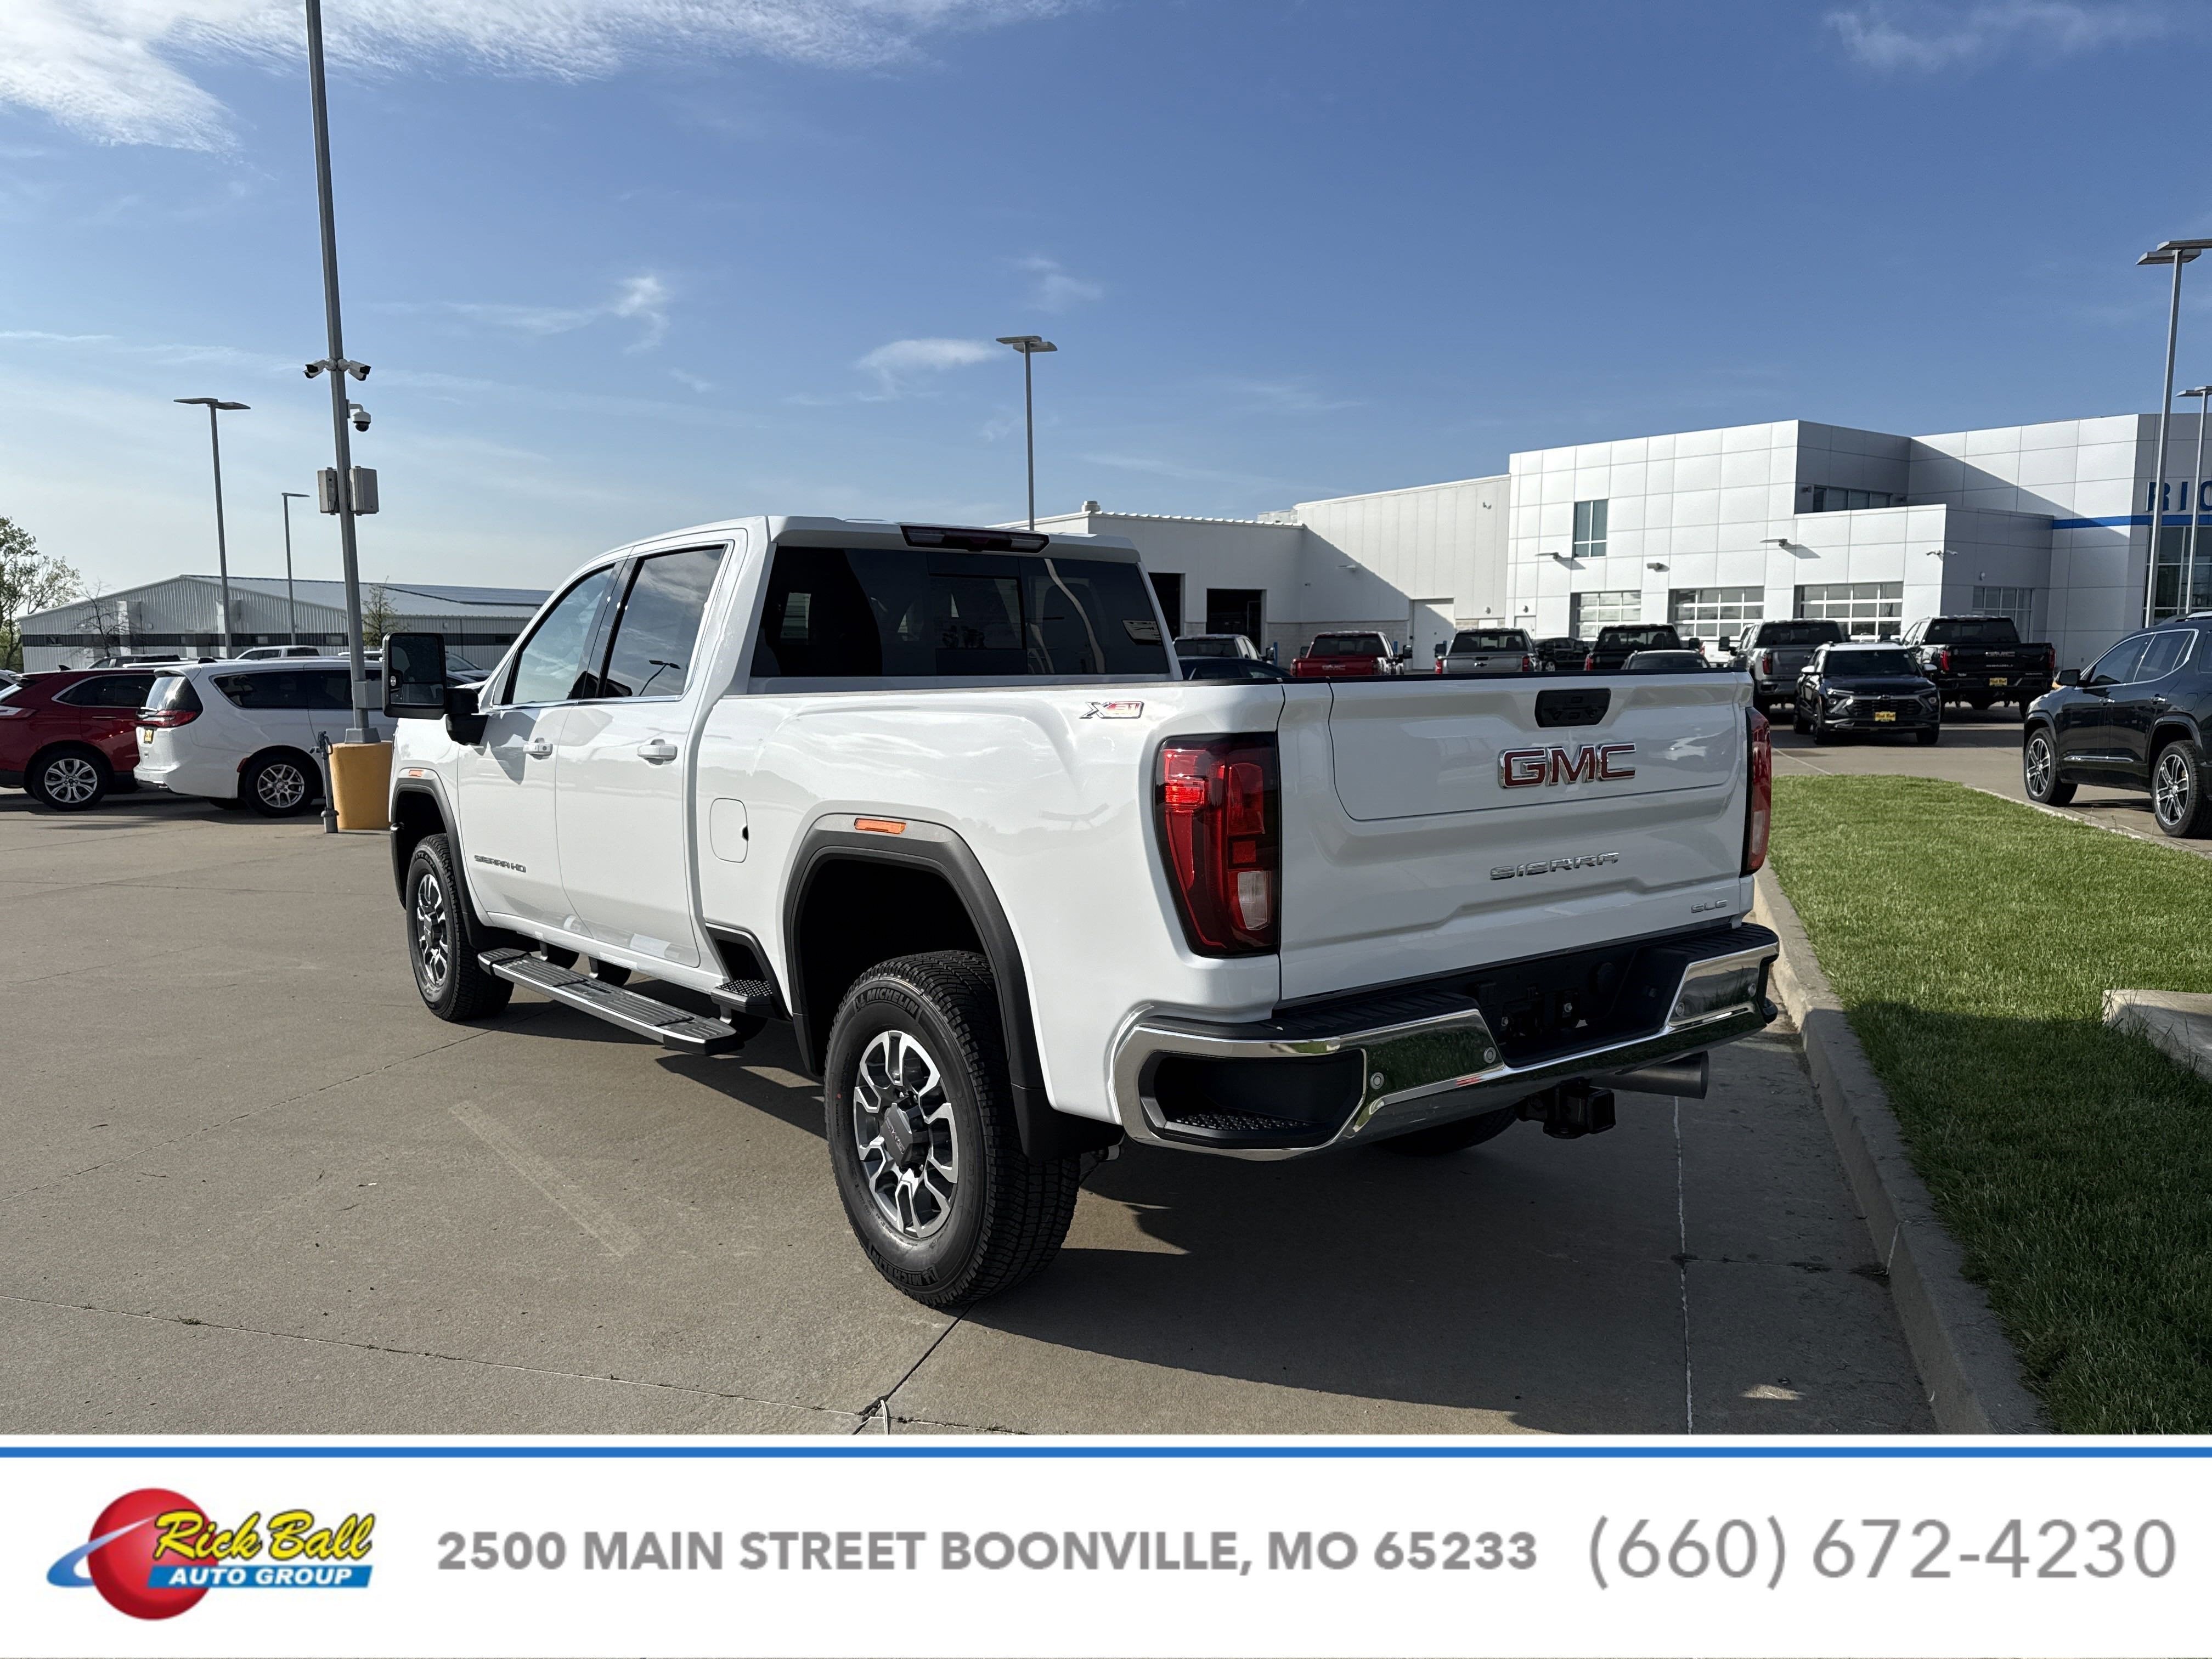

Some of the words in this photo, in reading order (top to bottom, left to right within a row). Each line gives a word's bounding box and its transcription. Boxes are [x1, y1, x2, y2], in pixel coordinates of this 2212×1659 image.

[1498, 741, 1637, 789] GMC
[474, 855, 510, 869] SIERRA
[510, 862, 527, 873] HD
[1490, 851, 1620, 881] SIERRA
[866, 988, 919, 1015] MICHELIN
